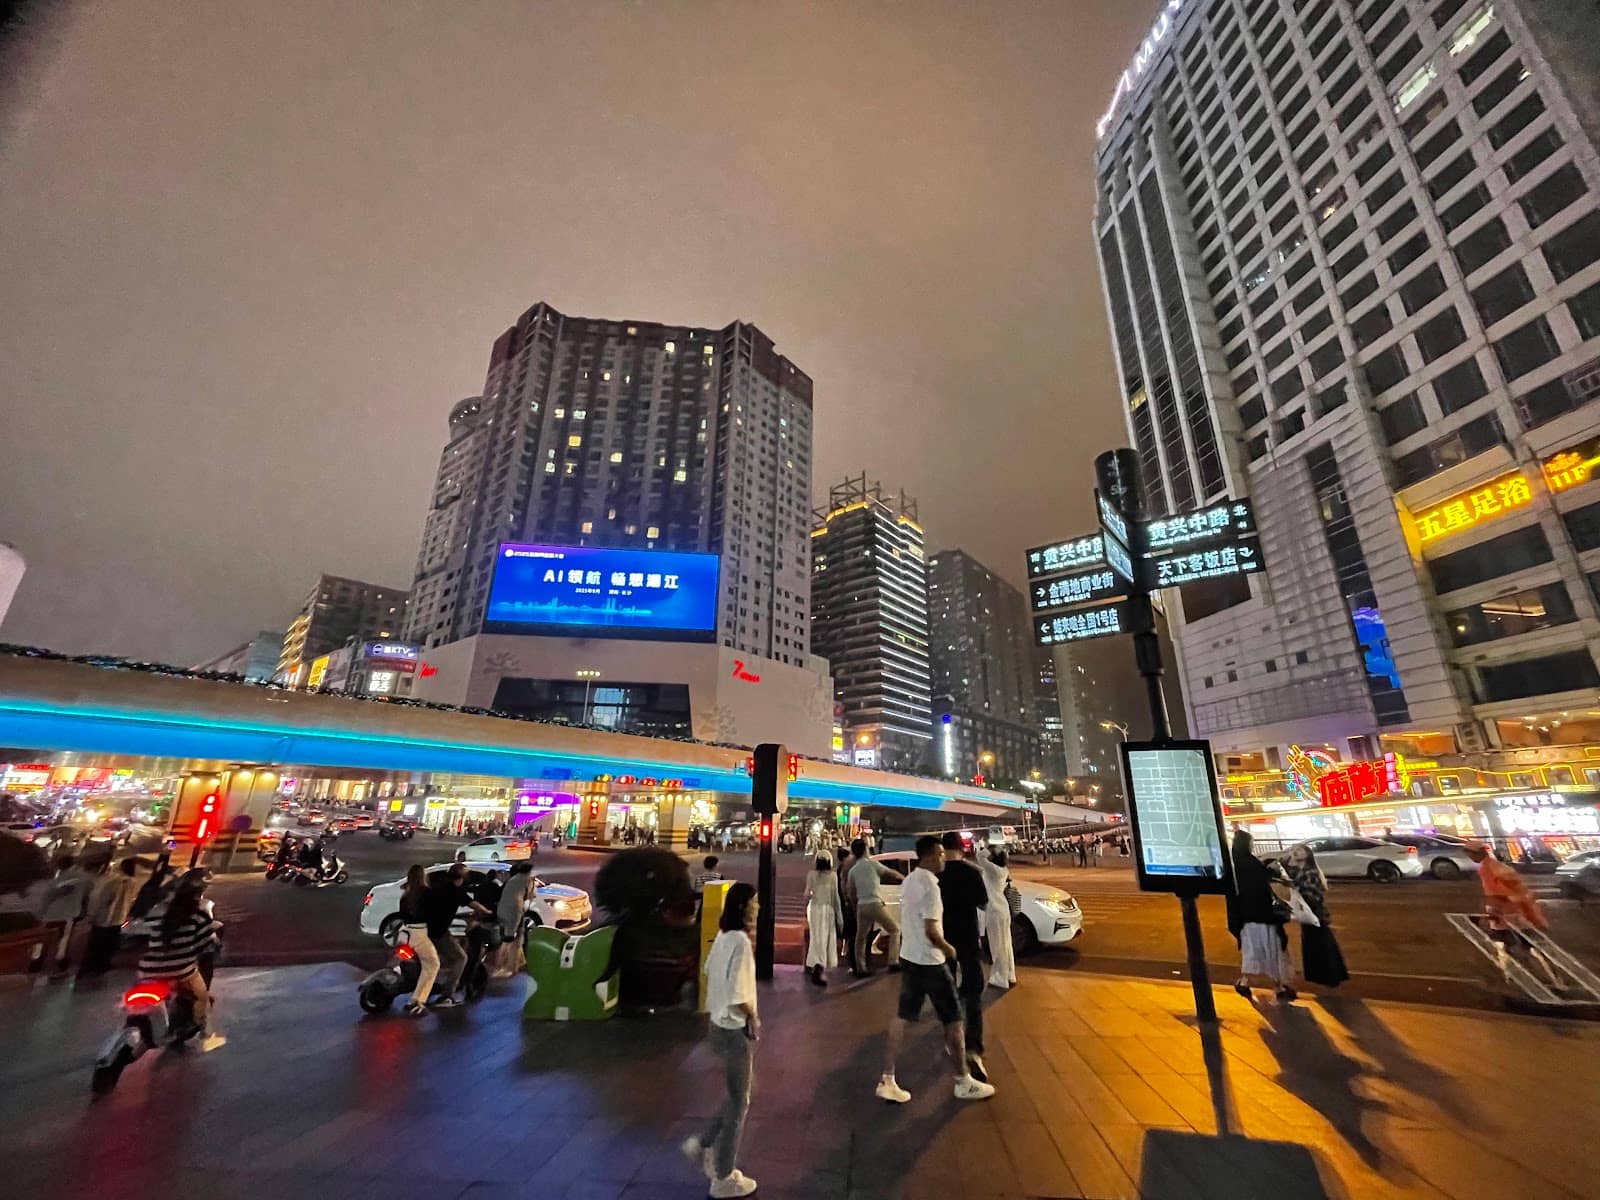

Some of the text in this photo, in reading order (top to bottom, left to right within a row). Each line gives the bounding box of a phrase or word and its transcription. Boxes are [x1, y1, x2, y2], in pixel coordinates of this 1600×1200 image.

[1147, 506, 1230, 540] 黄兴中路
[1232, 505, 1247, 517] 北
[1415, 476, 1532, 541] 五星足浴
[1157, 548, 1237, 578] 天下客饭店
[1049, 572, 1114, 599] 金满地商业街
